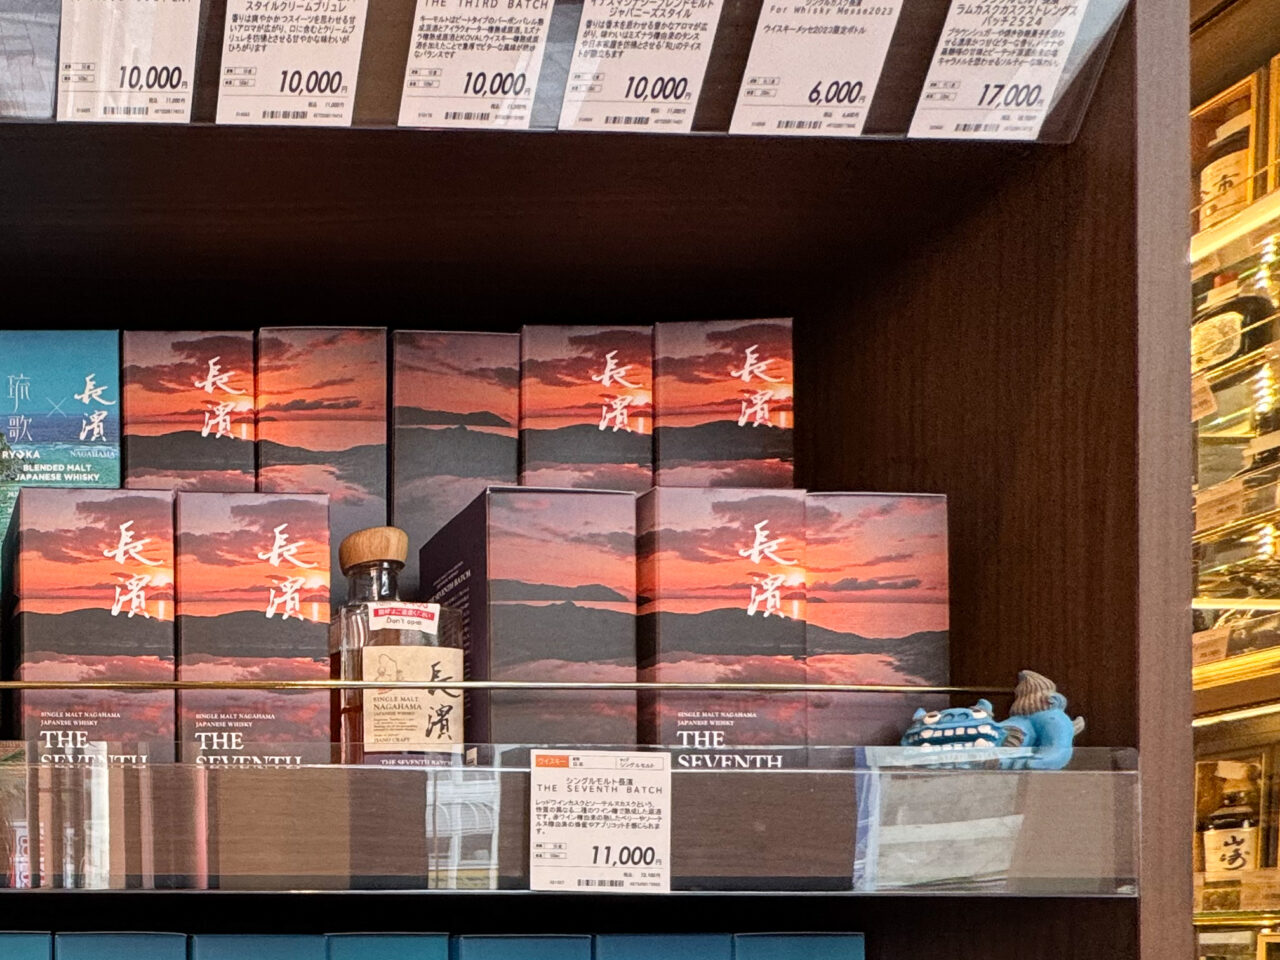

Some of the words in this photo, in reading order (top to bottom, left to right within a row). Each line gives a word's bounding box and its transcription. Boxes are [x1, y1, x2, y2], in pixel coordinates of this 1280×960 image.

[458, 0, 498, 8] THIRD
[507, 0, 548, 9] BATCH
[609, 8, 692, 18] ジャパニーズスタイル
[770, 5, 787, 13] For
[794, 6, 831, 15] Whisky
[592, 350, 643, 433] 長濱
[730, 344, 784, 428] 長濱
[194, 356, 247, 439] 長濱
[74, 373, 116, 442] 長濱
[23, 464, 65, 472] BLENDED
[66, 463, 92, 472] MALT
[14, 474, 61, 482] JAPANESE
[64, 473, 100, 481] WHISKY
[104, 520, 164, 619] 長濱
[257, 523, 318, 621] 長濱
[739, 520, 798, 619] 長濱
[373, 703, 421, 711] NAGAHAMA
[40, 731, 89, 748] THE
[195, 732, 244, 750] THE
[677, 731, 726, 749] THE
[537, 784, 558, 792] THE
[567, 784, 618, 793] SEVENTH
[626, 785, 663, 794] BATCH
